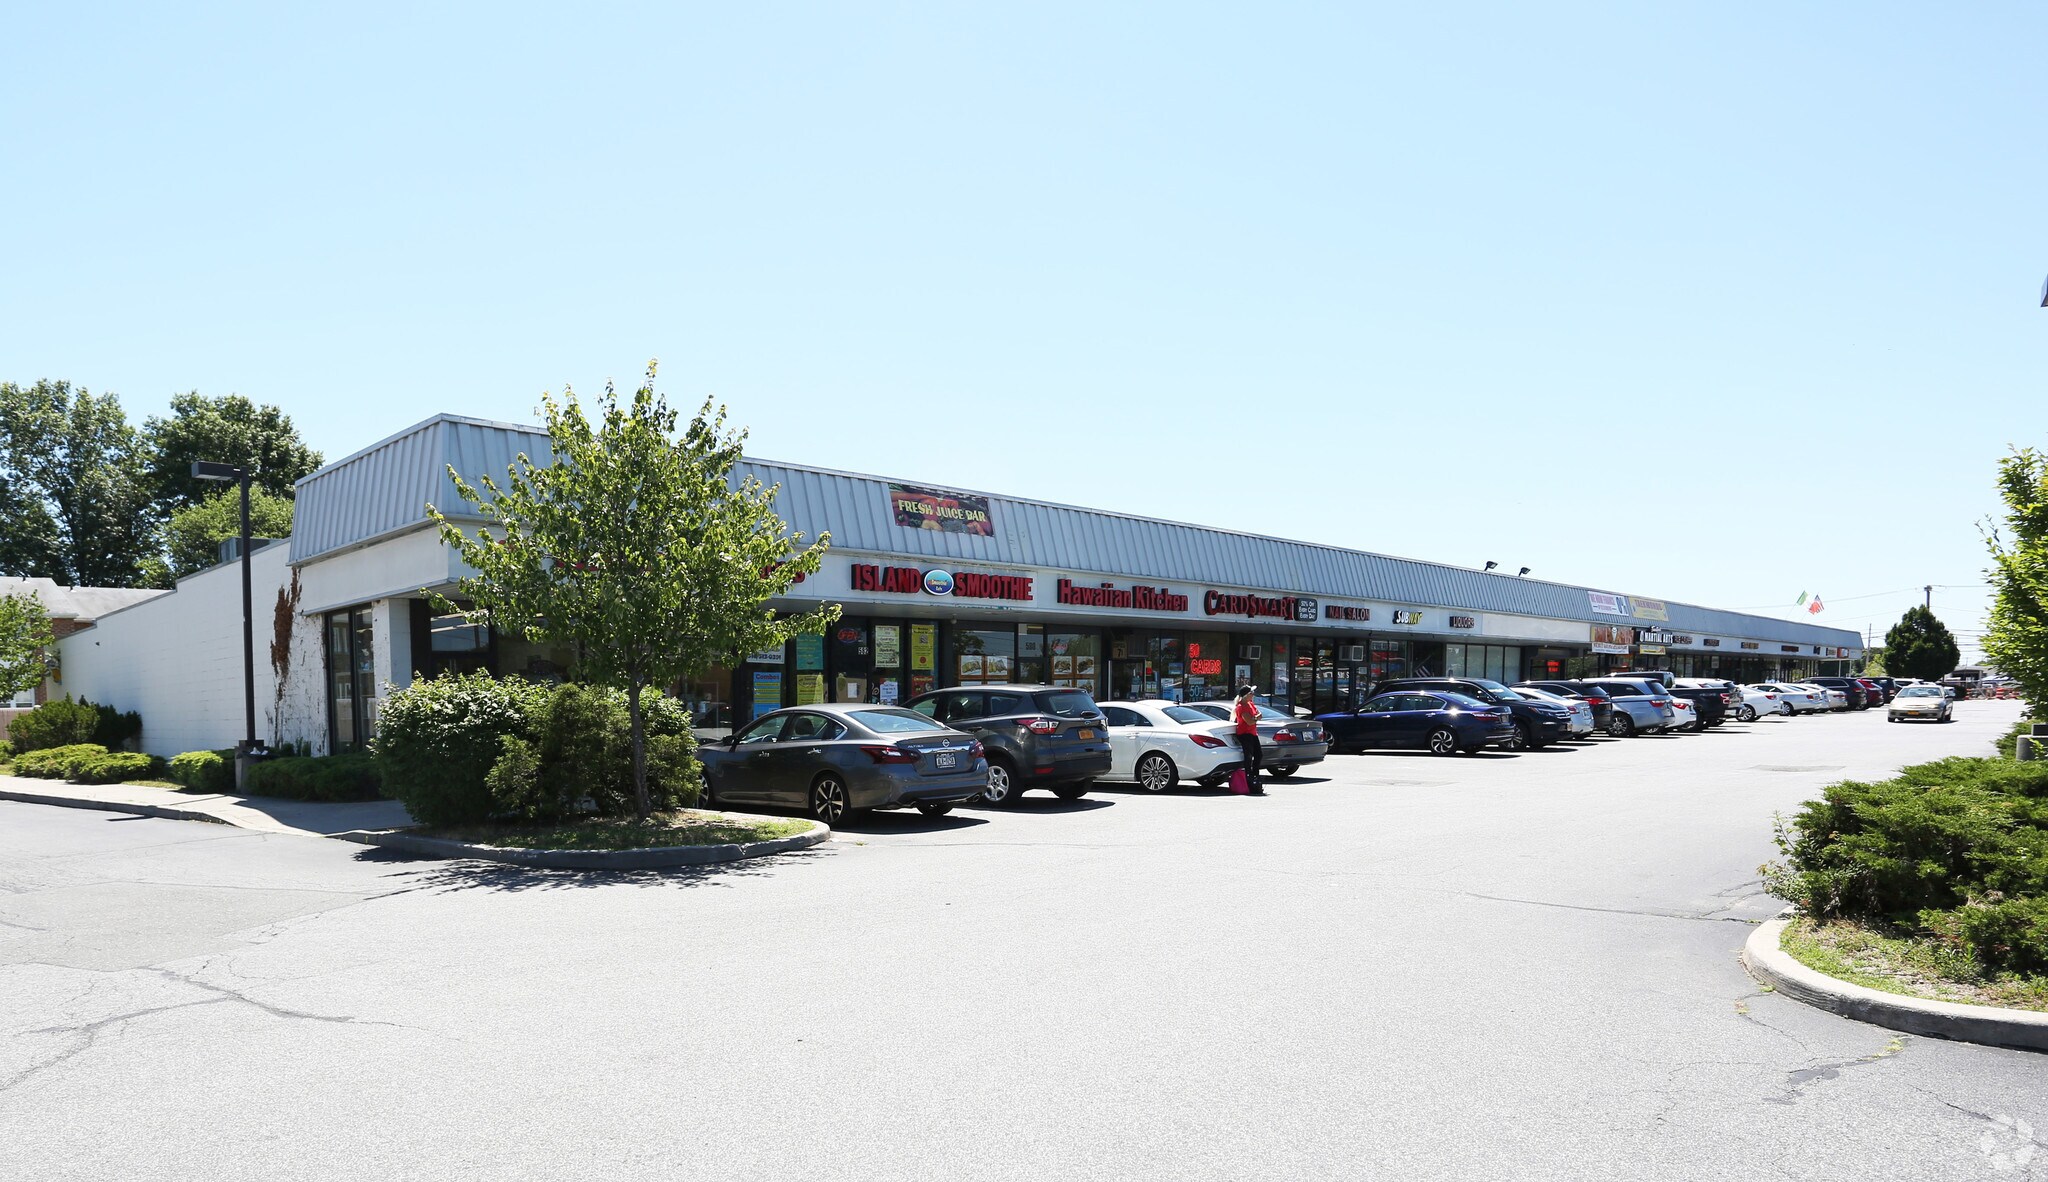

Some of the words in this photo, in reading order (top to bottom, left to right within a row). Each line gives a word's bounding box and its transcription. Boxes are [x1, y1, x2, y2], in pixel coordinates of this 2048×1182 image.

[898, 500, 933, 515] FRESH
[936, 506, 965, 520] JUICE
[965, 510, 986, 522] BAR
[852, 564, 922, 594] ISLAND
[952, 572, 1034, 601] SMOOTHIE
[1057, 578, 1132, 608] Hawaiian
[1132, 585, 1189, 611] Kitchen
[1326, 605, 1346, 619] NAIL
[1346, 607, 1370, 621] SALON
[1394, 610, 1423, 624] SUBWAY
[1191, 659, 1222, 674] CARDS
